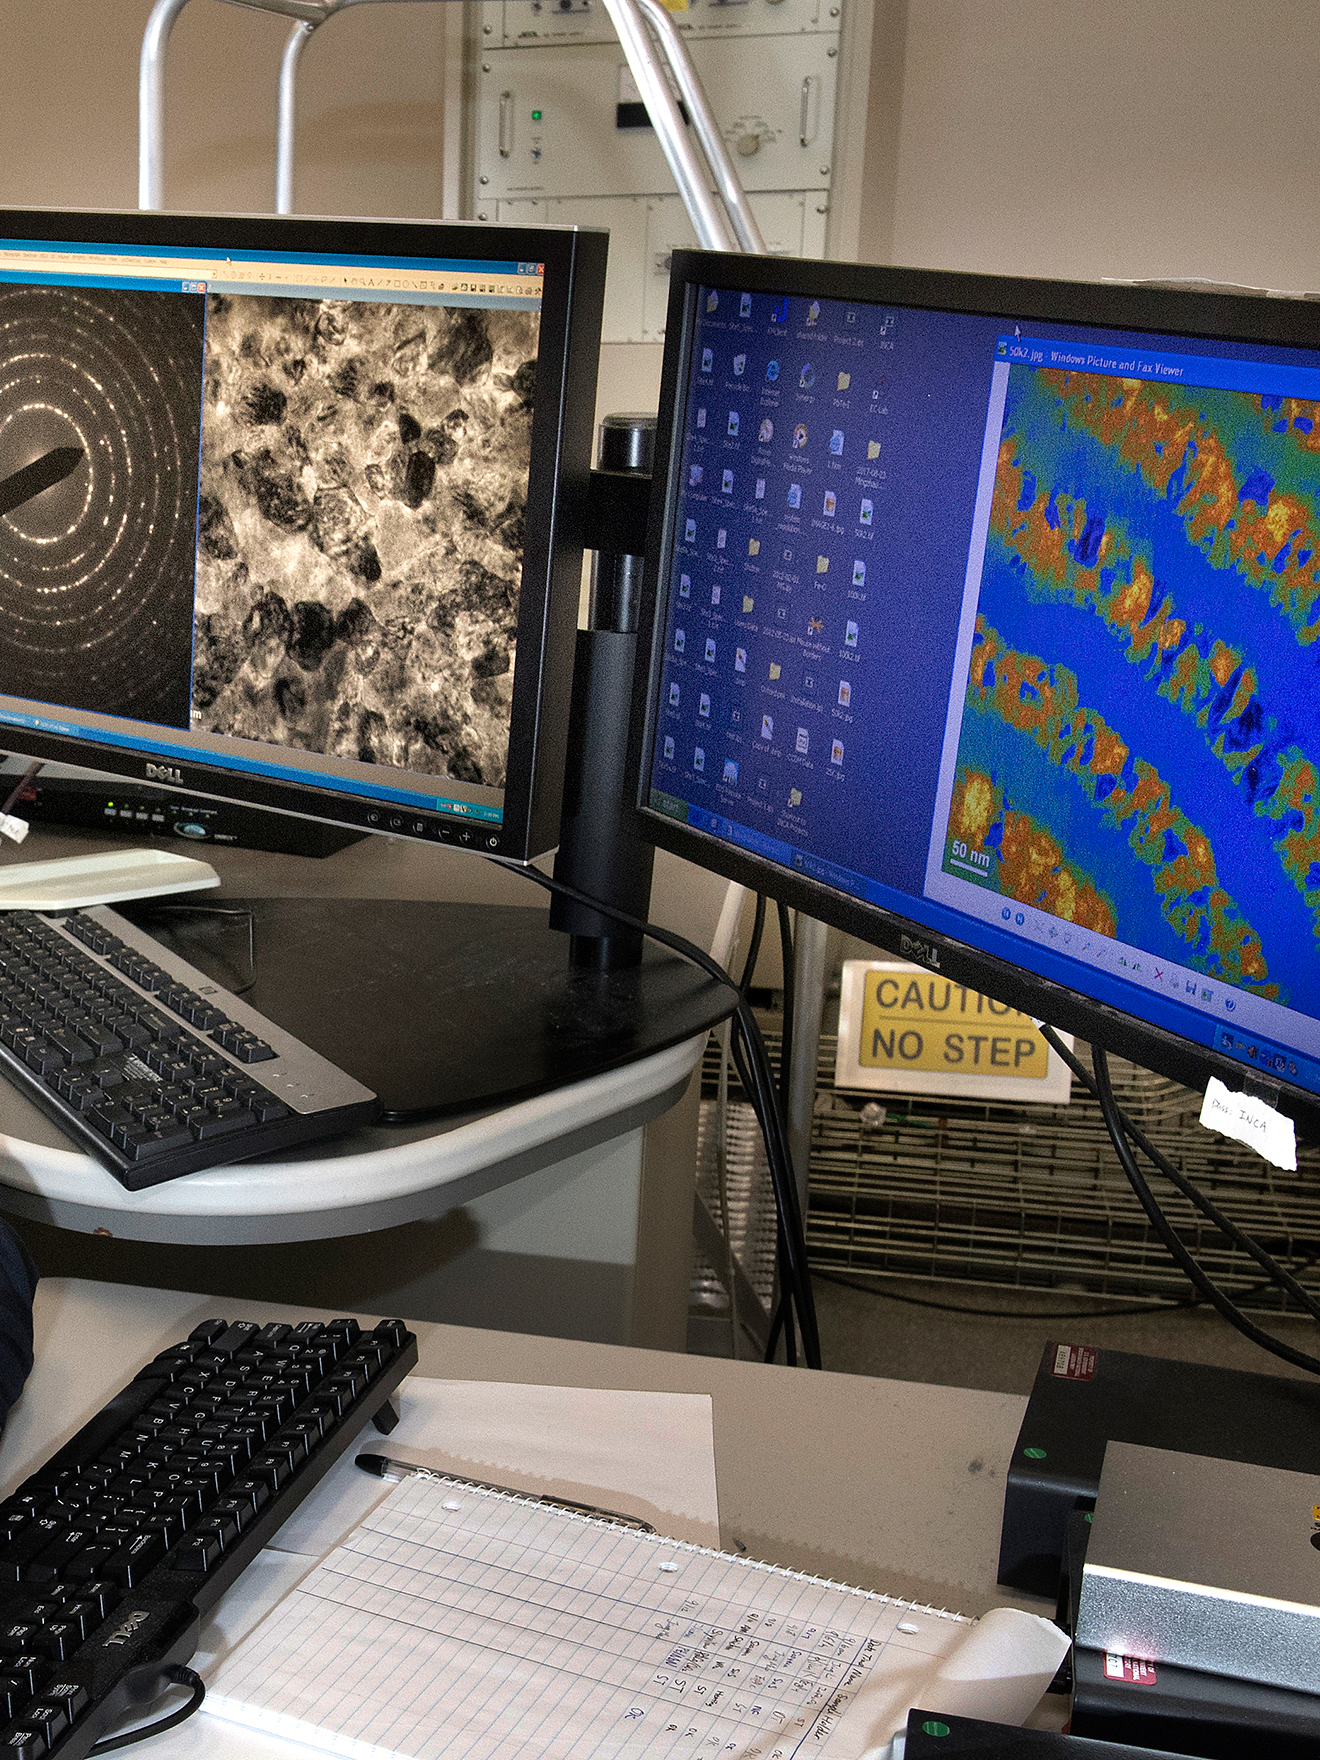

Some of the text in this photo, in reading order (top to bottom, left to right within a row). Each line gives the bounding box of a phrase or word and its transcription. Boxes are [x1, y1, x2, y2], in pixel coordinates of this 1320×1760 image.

[1051, 351, 1086, 365] Windows
[1087, 353, 1117, 369] Picture
[1119, 357, 1135, 371] and
[1137, 360, 1153, 373] Fax
[1155, 361, 1184, 377] Viewer
[145, 762, 185, 784] DELL
[951, 840, 990, 868] 50 nm
[900, 934, 940, 968] DELL
[876, 979, 1026, 1016] CAUTI
[872, 1028, 1036, 1068] NO STEP
[1239, 1109, 1267, 1132] INCA
[120, 1450, 131, 1458] M
[102, 1610, 151, 1647] DELL
